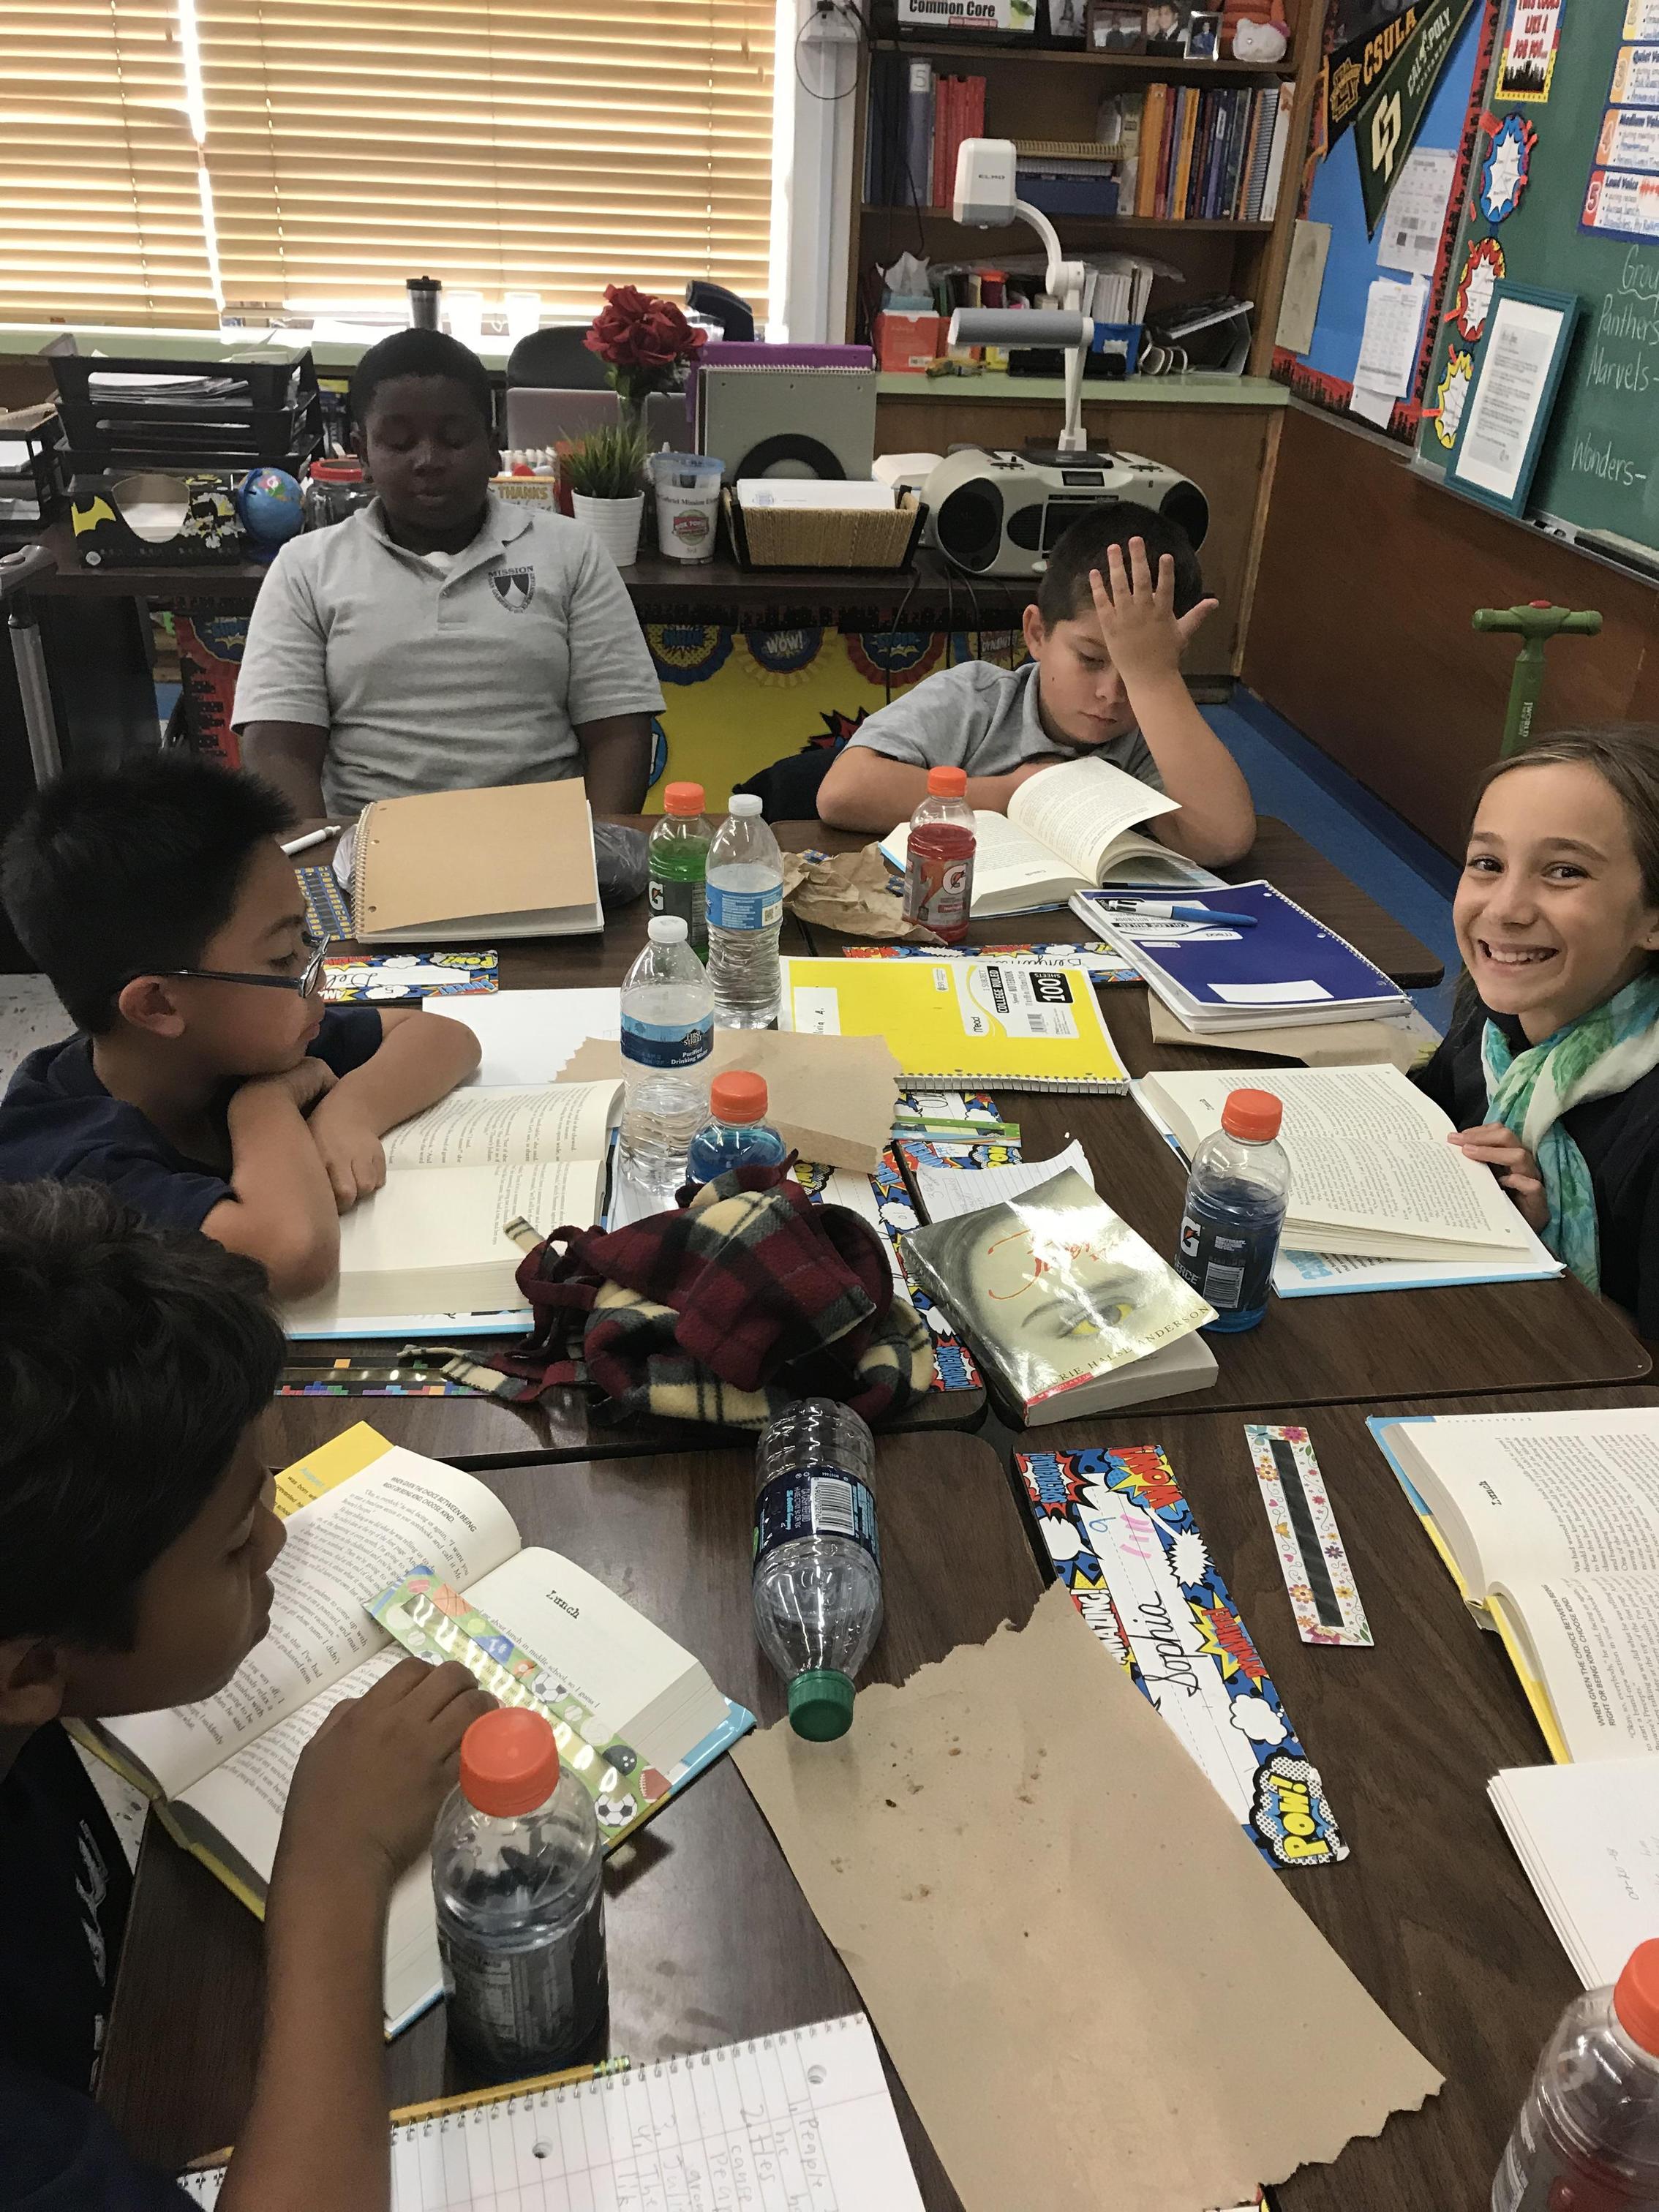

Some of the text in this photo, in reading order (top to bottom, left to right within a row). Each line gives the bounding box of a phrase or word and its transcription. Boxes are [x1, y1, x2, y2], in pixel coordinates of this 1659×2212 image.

[909, 0, 996, 18] Common Core
[1426, 7, 1451, 48] POLY
[1541, 15, 1549, 34] A
[1363, 7, 1417, 86] CSULA
[914, 69, 926, 88] 5
[1586, 181, 1601, 213] 5
[497, 486, 549, 500] THANKS
[488, 565, 533, 576] MISSION
[765, 631, 804, 654] WOW!
[942, 864, 967, 895] G
[649, 880, 665, 911] G
[988, 970, 1008, 1013] COLLEGE RULED
[1004, 971, 1017, 992] NOTEBOOK
[1037, 977, 1066, 1002] 100
[683, 1037, 702, 1047] STREET
[685, 1030, 700, 1040] FIRST
[671, 1054, 696, 1066] Drinking
[682, 1046, 703, 1058] Purified
[1180, 1216, 1202, 1257] G
[1087, 1344, 1132, 1369] HALSE
[1137, 1305, 1210, 1347] ANDERSON
[287, 1475, 310, 1495] was born
[1033, 1453, 1068, 1504] SPECTACULAR!
[1109, 1446, 1184, 1511] WOW!
[1477, 1479, 1502, 1507] Lunch
[402, 1479, 478, 1533] GIVEN CHOICE BETWEEN BEING
[420, 1498, 455, 1524] CHOOSE KIND.
[1560, 1524, 1581, 1573] Via had warned
[1564, 1513, 1590, 1573] should have known
[1579, 1524, 1600, 1572] to be this hard.
[1590, 1527, 1604, 1549] poured
[1630, 1534, 1640, 1546] else
[431, 1536, 452, 1564] and call
[452, 1546, 470, 1577] want you
[1598, 1550, 1609, 1572] classes
[1600, 1530, 1619, 1571] and bumping
[1612, 1535, 1628, 1571] One of the
[1627, 1549, 1638, 1570] saving
[1640, 1560, 1647, 1570] no
[546, 1588, 582, 1620] Lunch
[1614, 1609, 1624, 1621] was
[1584, 1610, 1599, 1631] facing
[1600, 1624, 1613, 1640] your
[1619, 1622, 1628, 1631] he
[336, 1622, 360, 1655] and mail
[354, 1629, 369, 1648] with
[1142, 1590, 1202, 1697] Sophia
[1200, 1607, 1266, 1679] DYNAMITE!
[1594, 1632, 1606, 1648] said,
[1608, 1641, 1617, 1649] in
[1623, 1631, 1636, 1649] what
[324, 1642, 342, 1666] didn't
[1542, 1583, 1606, 1726] WHEN GIVEN THE CHOICE BETWEEN BEING
[1560, 1595, 1616, 1726] RIGHT OR BEING CHOOSE KIND.
[1600, 1649, 1609, 1658] he
[1611, 1650, 1626, 1676] section
[1630, 1649, 1641, 1662] did
[297, 1665, 313, 1688] from
[308, 1662, 323, 1681] had
[505, 1628, 595, 1707] lunch middle school, guess
[1636, 1662, 1644, 1672] we
[256, 1673, 270, 1688] way
[1602, 1658, 1625, 1701] everybody,”
[253, 1686, 271, 1707] relax
[1620, 1677, 1640, 1716] brand-new
[1641, 1681, 1658, 1708] talking
[249, 1698, 266, 1719] with
[230, 1714, 246, 1733] said
[1638, 1724, 1649, 1741] start
[1644, 1742, 1652, 1751] to
[1268, 1775, 1331, 1859] POW!
